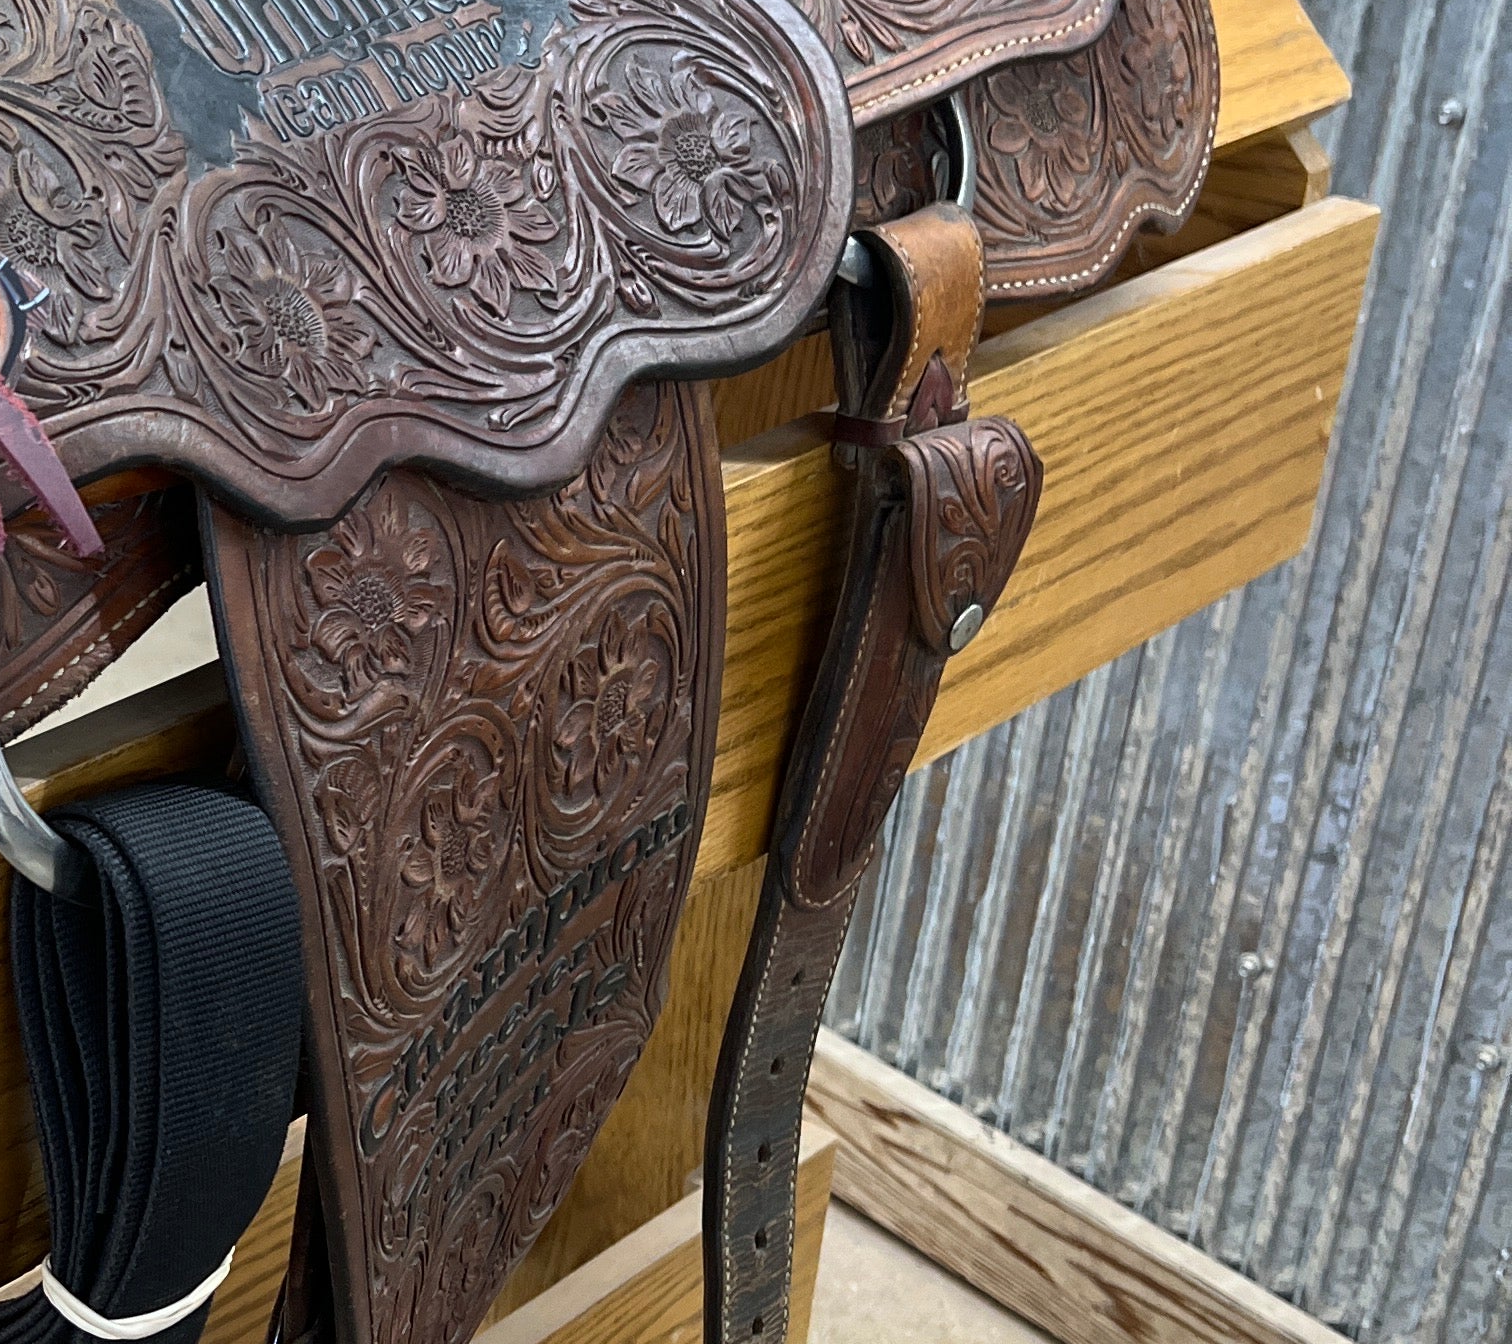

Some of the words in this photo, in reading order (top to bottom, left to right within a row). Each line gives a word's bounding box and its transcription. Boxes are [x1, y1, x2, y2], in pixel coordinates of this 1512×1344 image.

[258, 64, 388, 143] Team
[358, 801, 692, 1158] Champion
[430, 940, 590, 1130] Heeler
[400, 959, 629, 1242] Finals
